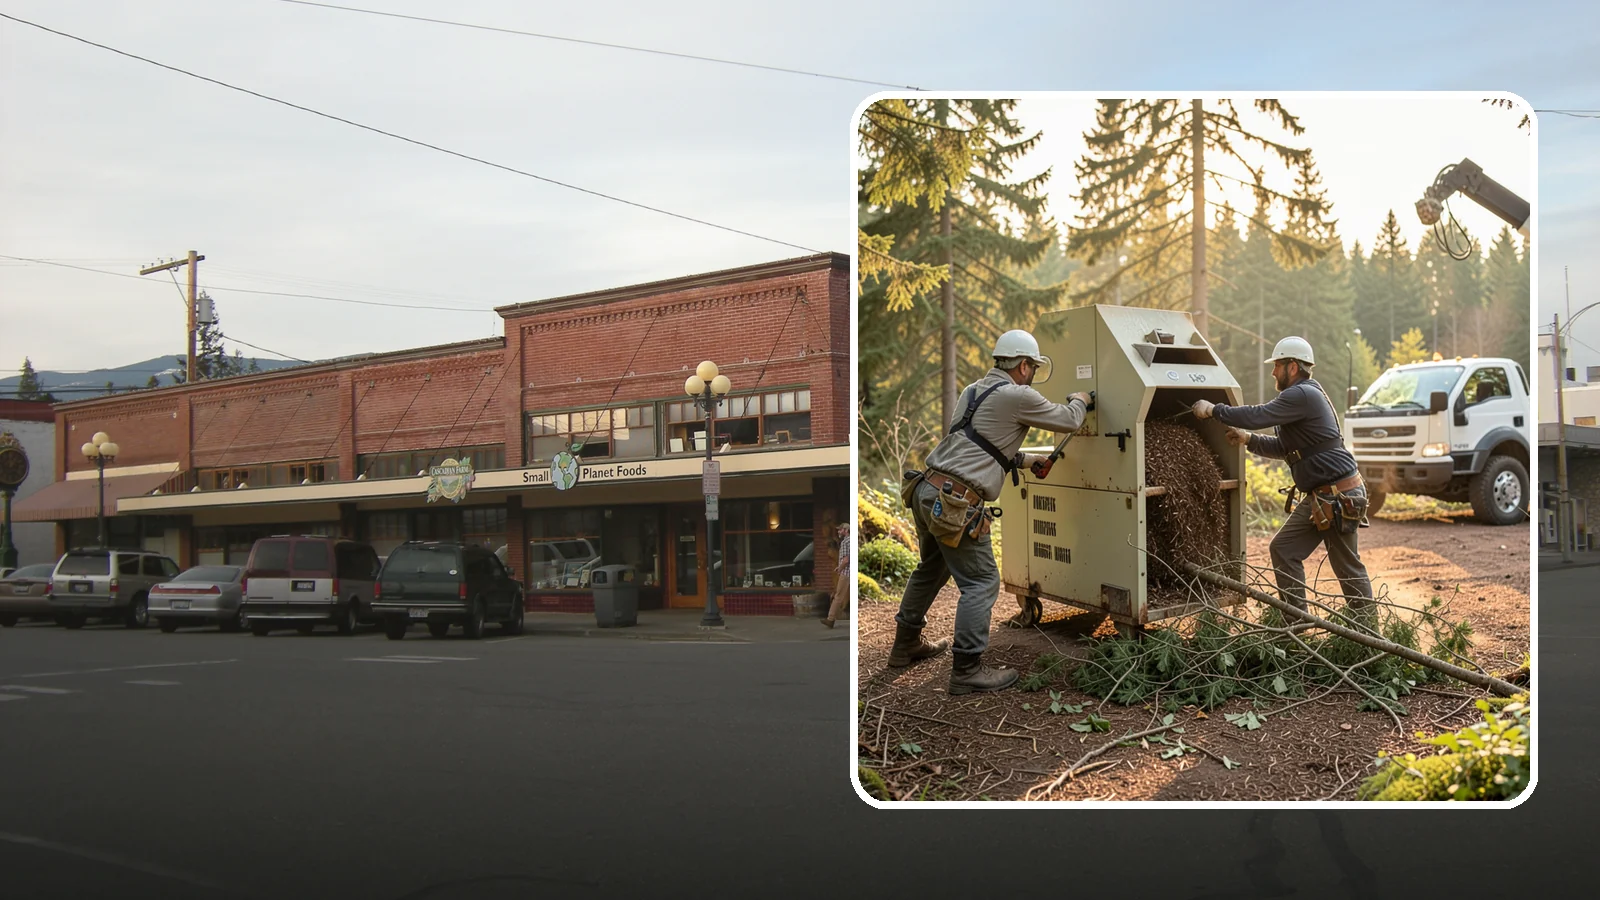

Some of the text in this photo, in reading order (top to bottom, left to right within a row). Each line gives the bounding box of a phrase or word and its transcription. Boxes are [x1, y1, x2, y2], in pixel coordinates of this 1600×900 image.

[456, 466, 470, 475] FARM
[523, 464, 647, 483] Small Planet Foods
